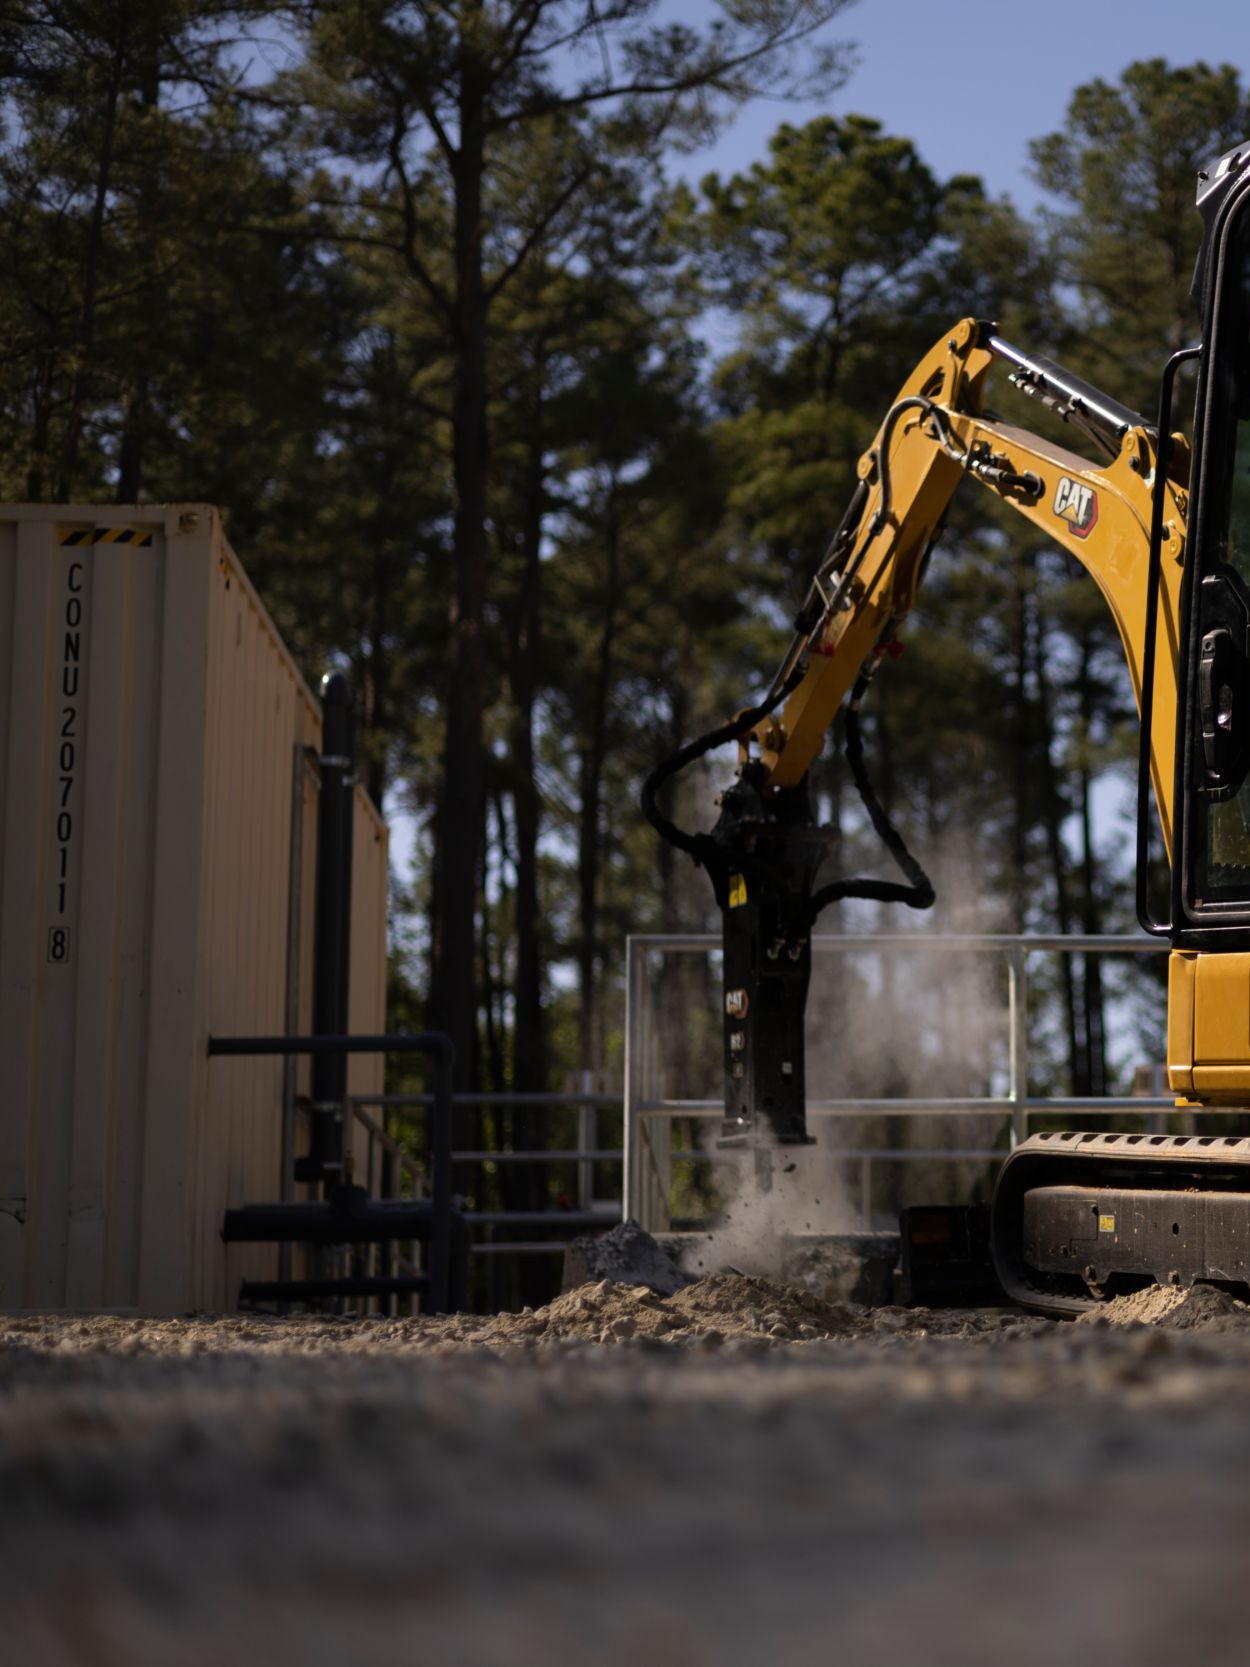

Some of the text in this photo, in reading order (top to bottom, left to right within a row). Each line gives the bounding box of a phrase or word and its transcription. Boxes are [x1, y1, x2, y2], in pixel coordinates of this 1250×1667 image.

[1054, 477, 1093, 525] CAT
[51, 563, 82, 960] CONU 207011 8
[725, 990, 744, 1014] CAT
